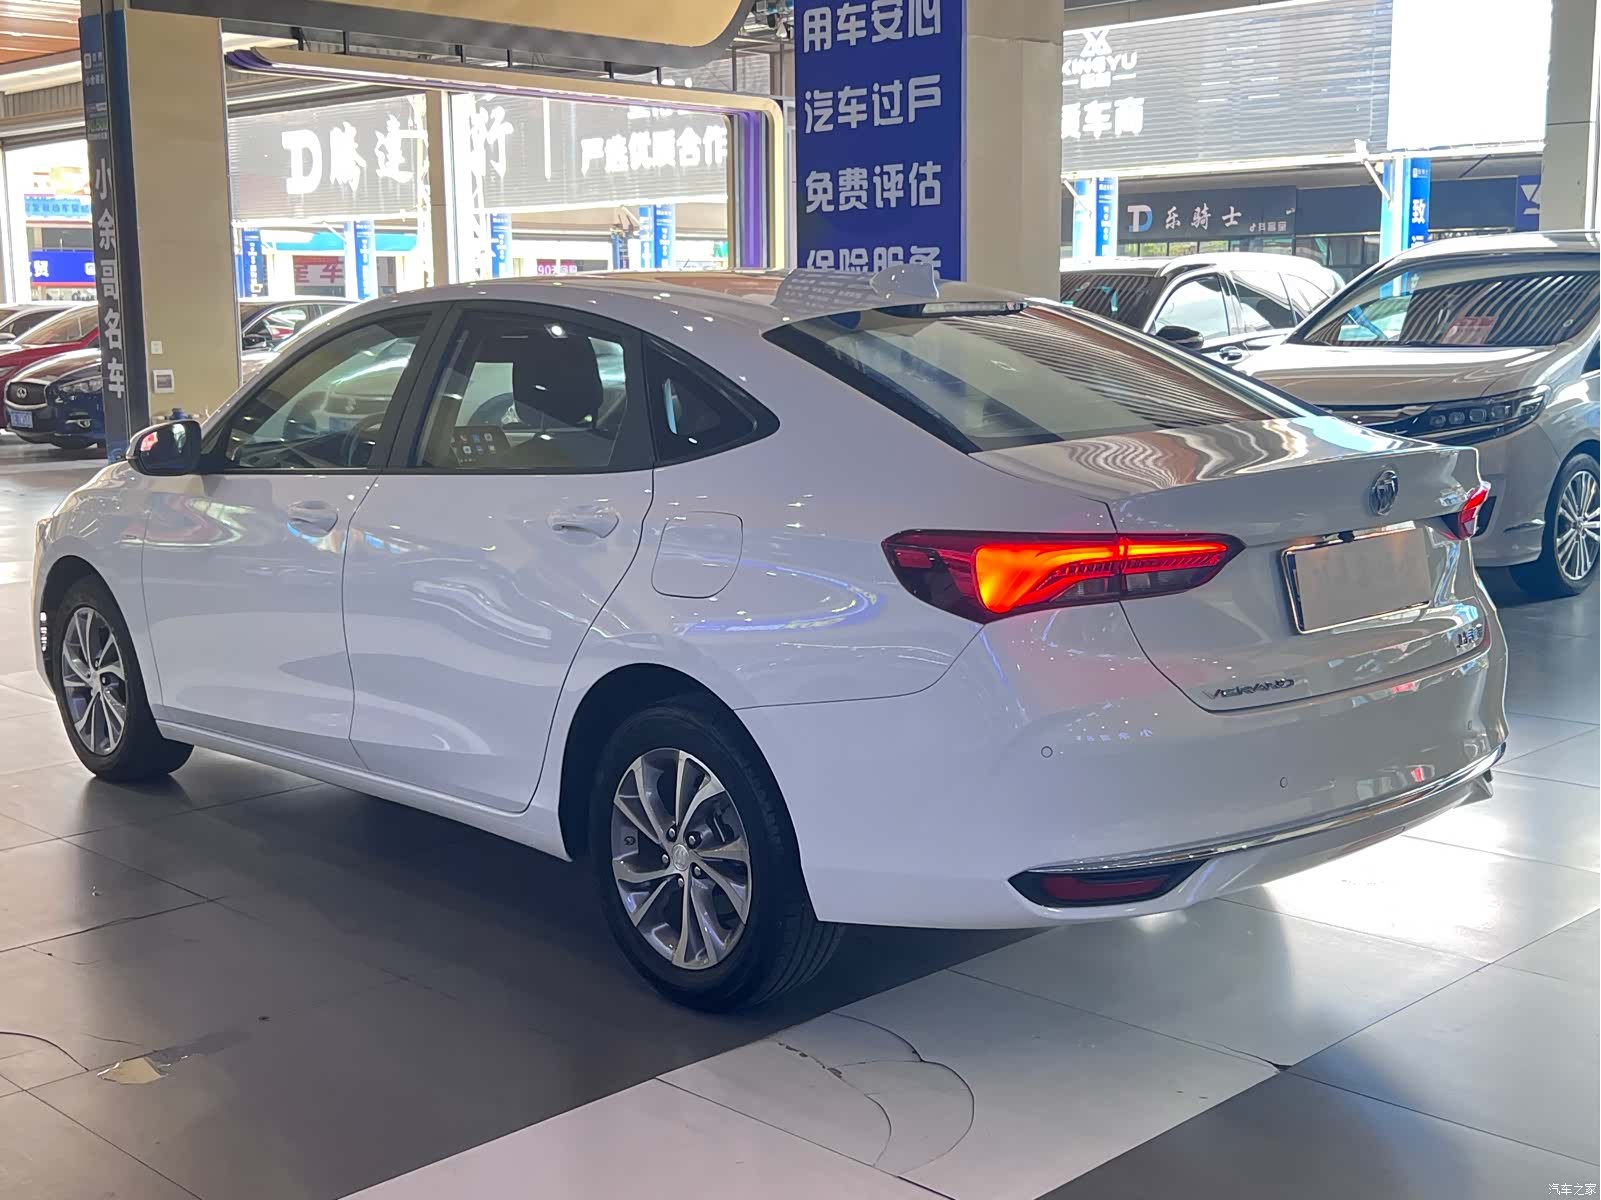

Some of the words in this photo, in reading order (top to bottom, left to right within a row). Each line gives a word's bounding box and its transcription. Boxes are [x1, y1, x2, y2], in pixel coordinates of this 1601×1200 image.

[803, 0, 942, 53] 用车安心
[804, 74, 942, 134] 汽车过户
[805, 160, 943, 214] 免费评估
[1165, 203, 1243, 231] 乐骑士
[95, 158, 125, 398] 小余哥名车
